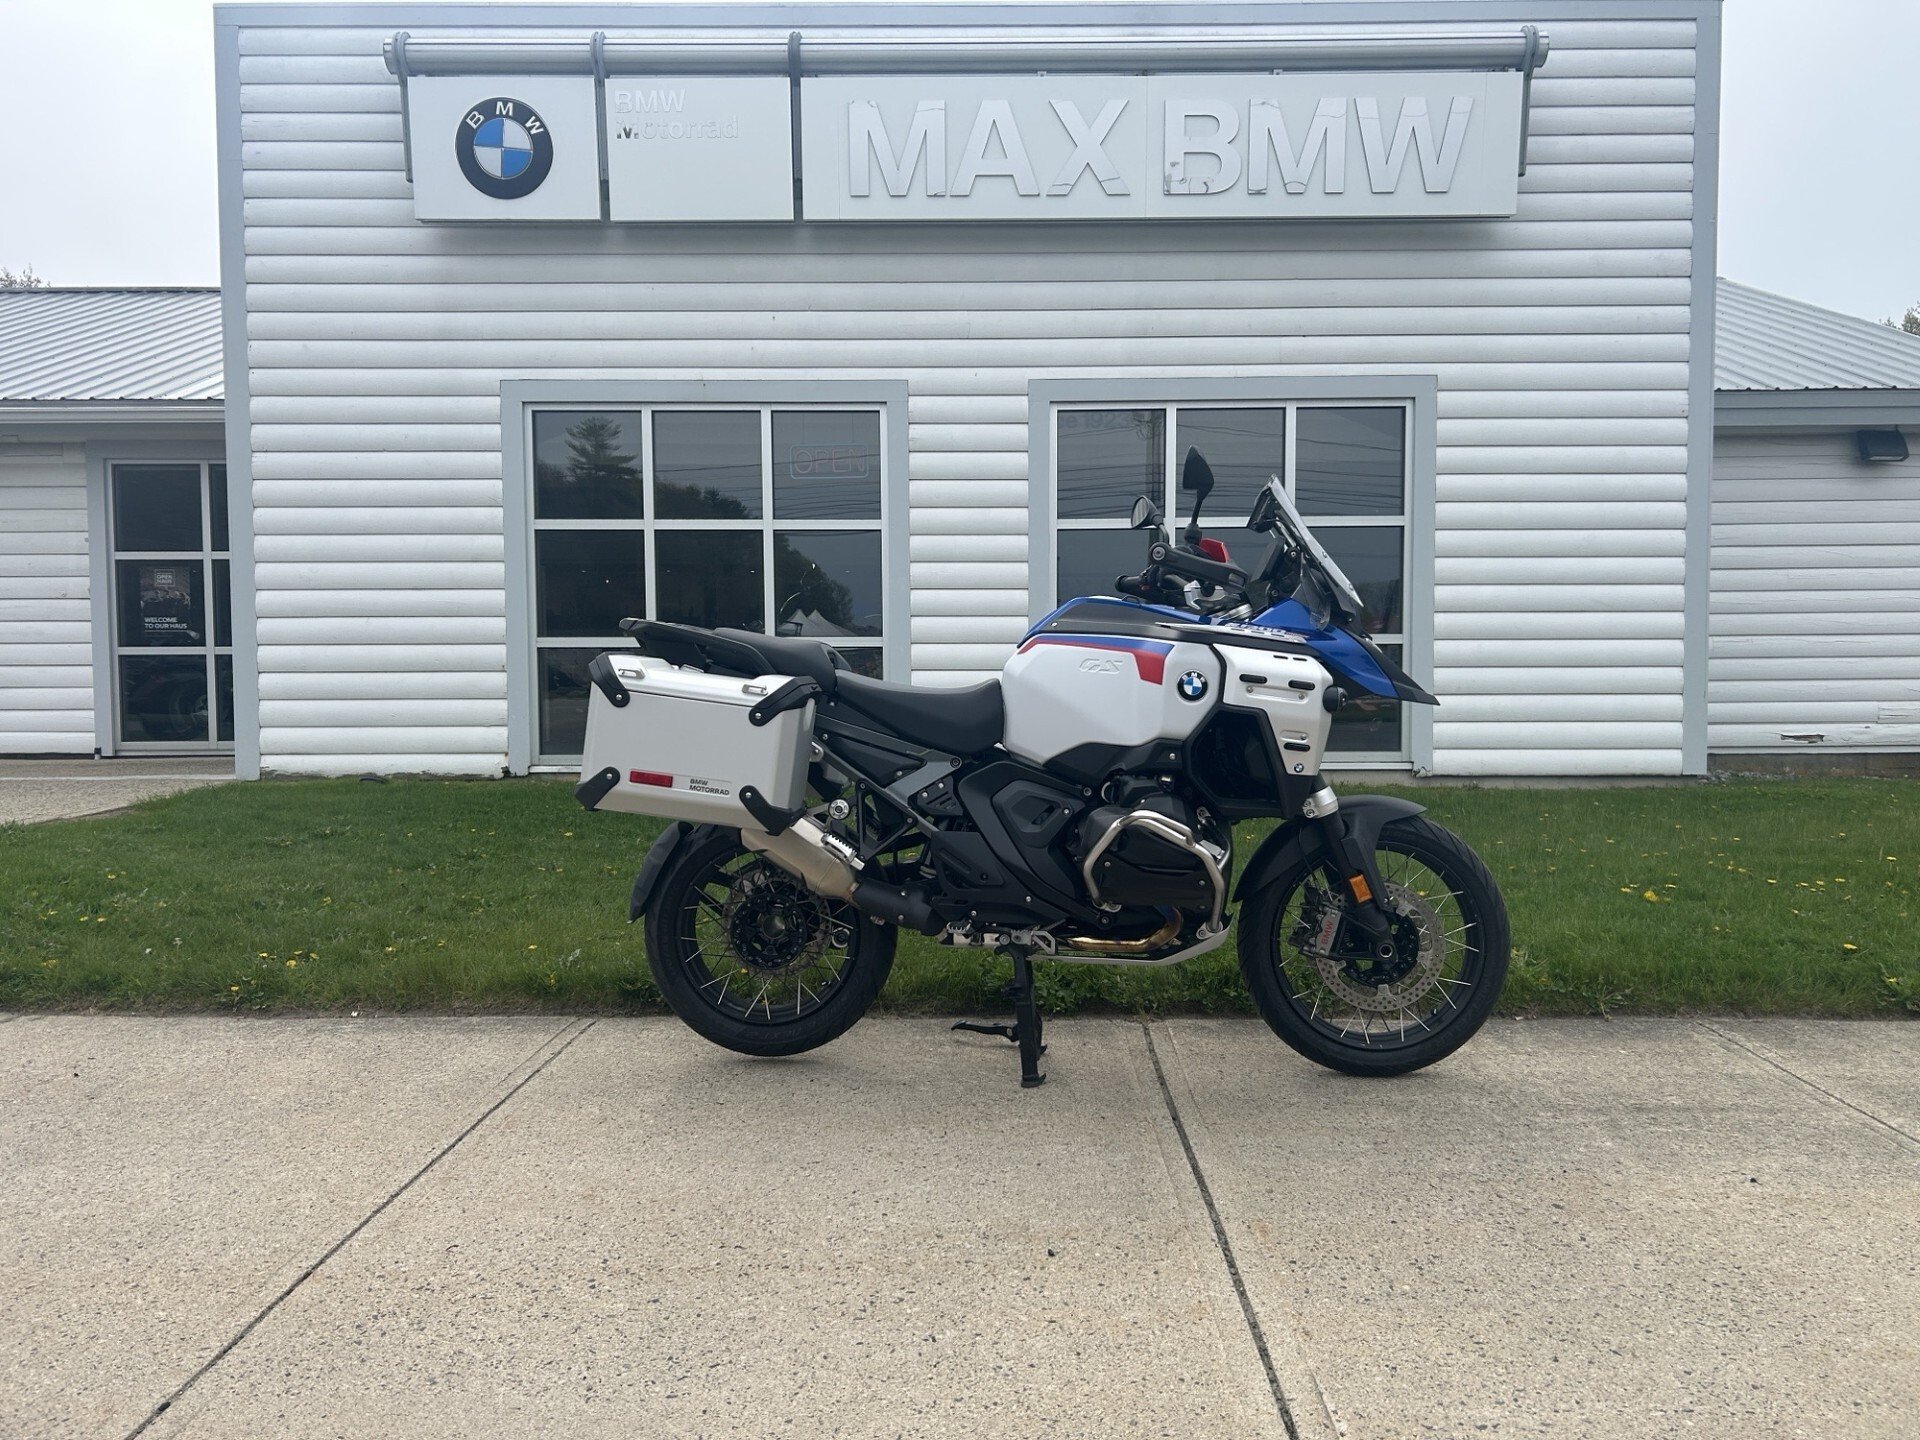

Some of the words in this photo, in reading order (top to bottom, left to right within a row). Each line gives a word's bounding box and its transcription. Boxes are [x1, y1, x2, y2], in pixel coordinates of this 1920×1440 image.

[615, 87, 686, 114] BMW
[465, 101, 544, 136] BMW
[616, 115, 739, 140] Motorrad
[847, 99, 1131, 198] MAX
[1163, 97, 1475, 197] BMW
[794, 448, 865, 474] OPEN
[1079, 658, 1123, 674] GS
[689, 785, 730, 795] MOTORRAD
[690, 778, 709, 786] BMW
[1321, 920, 1333, 945] BMW
